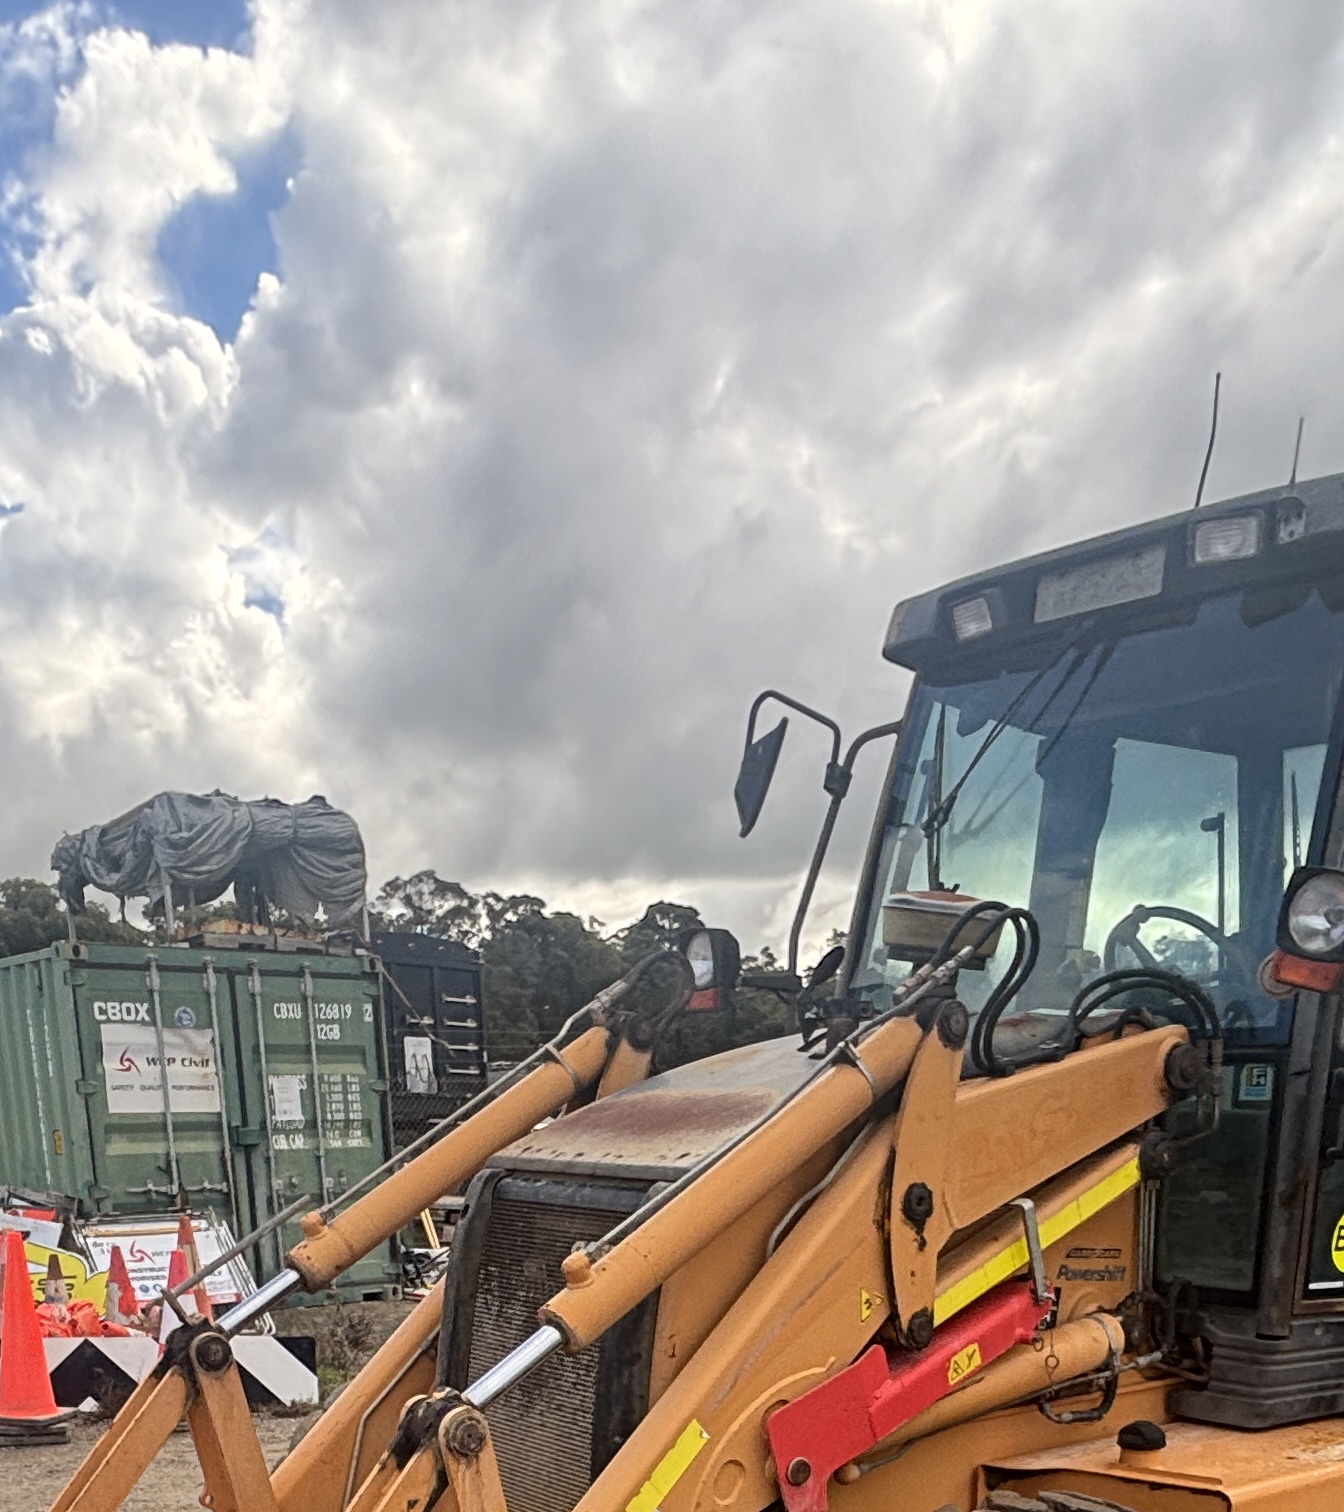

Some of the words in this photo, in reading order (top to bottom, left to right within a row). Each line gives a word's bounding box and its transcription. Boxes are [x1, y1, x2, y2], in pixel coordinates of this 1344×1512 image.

[93, 1001, 151, 1021] CBOX
[273, 1002, 302, 1019] CBXU
[314, 1003, 352, 1019] 126819
[317, 1023, 341, 1040] 12GB
[145, 1056, 176, 1068] WP
[180, 1057, 210, 1068] Civil
